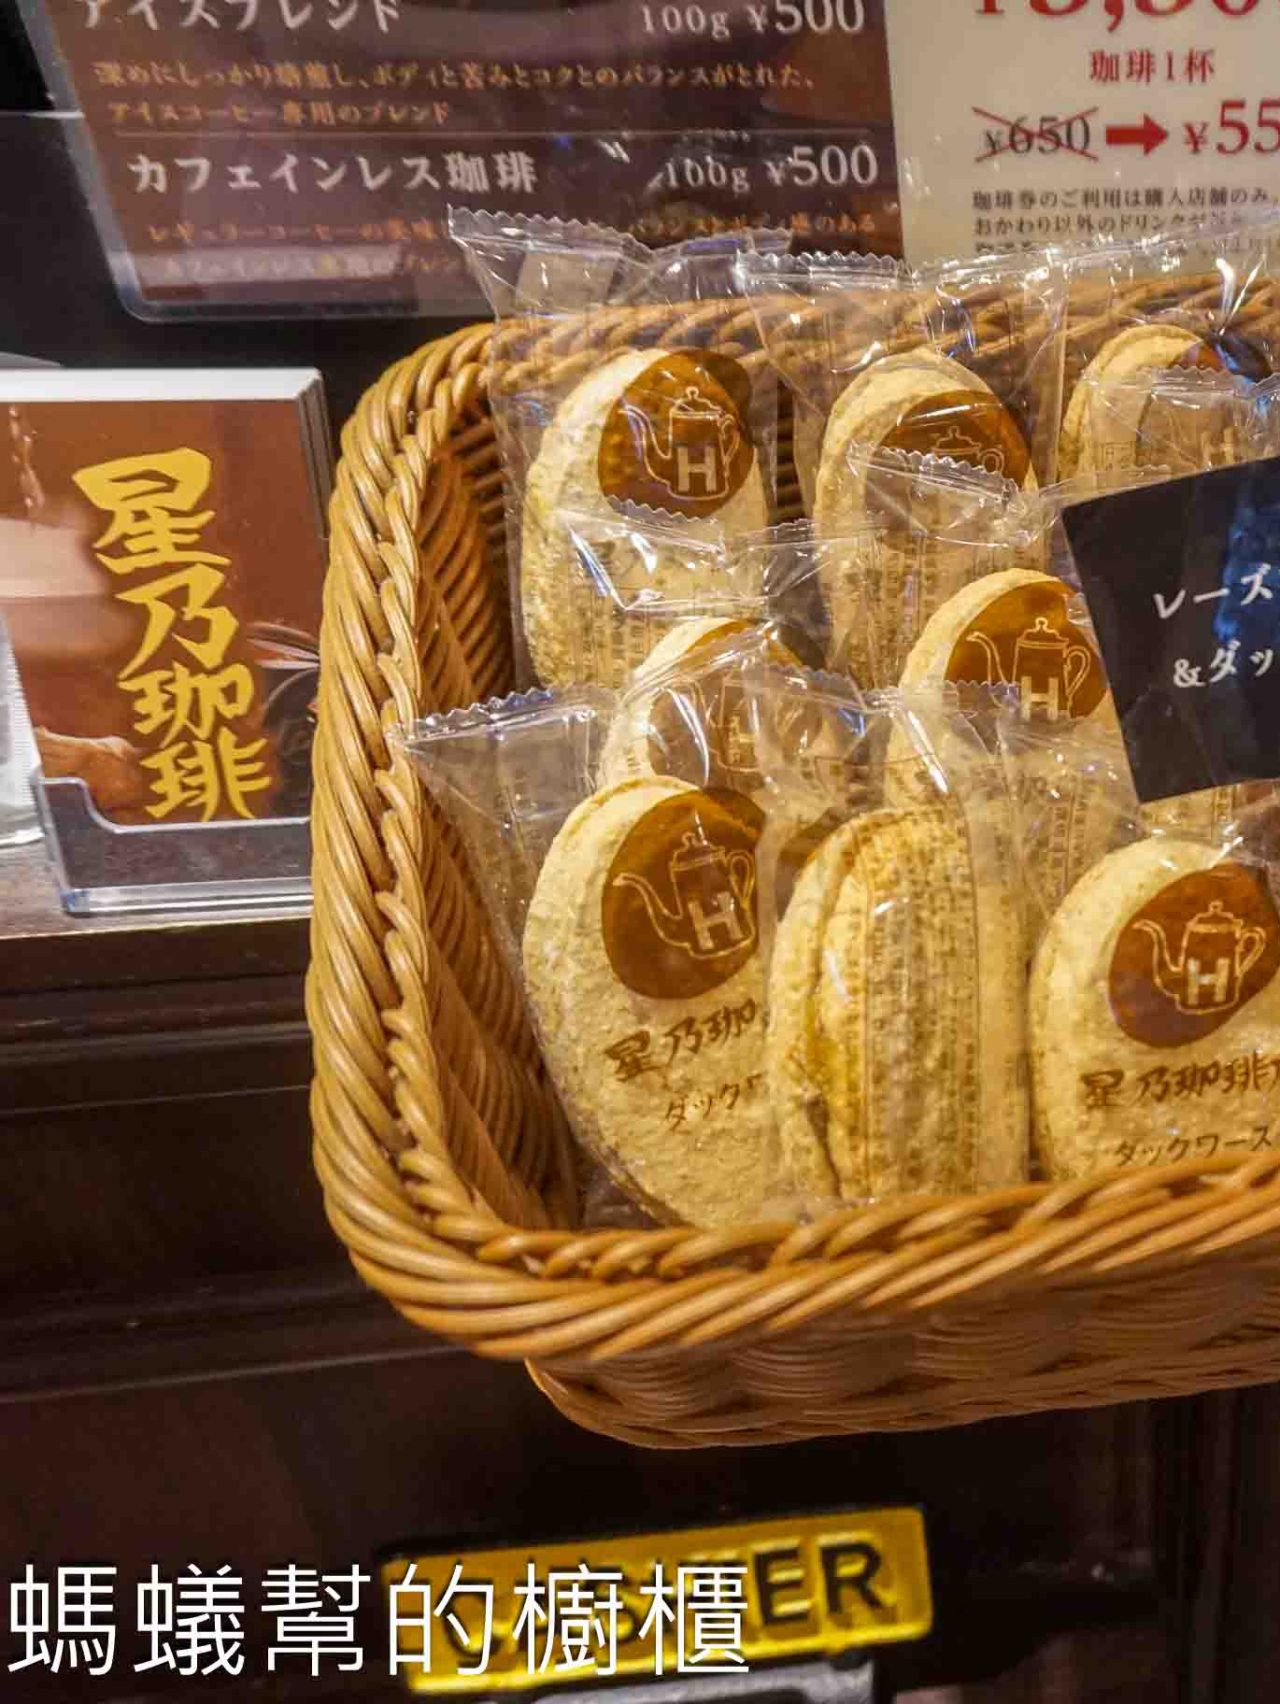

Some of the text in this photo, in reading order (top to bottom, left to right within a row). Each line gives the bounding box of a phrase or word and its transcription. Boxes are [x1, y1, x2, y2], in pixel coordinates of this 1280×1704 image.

[642, 4, 731, 39] 100g
[748, 0, 866, 34] ¥500
[1088, 48, 1215, 85] 珈琲1杯
[127, 144, 879, 195] カフェインレス珈琲 100g ¥500
[72, 447, 272, 822] 星乃珈琲
